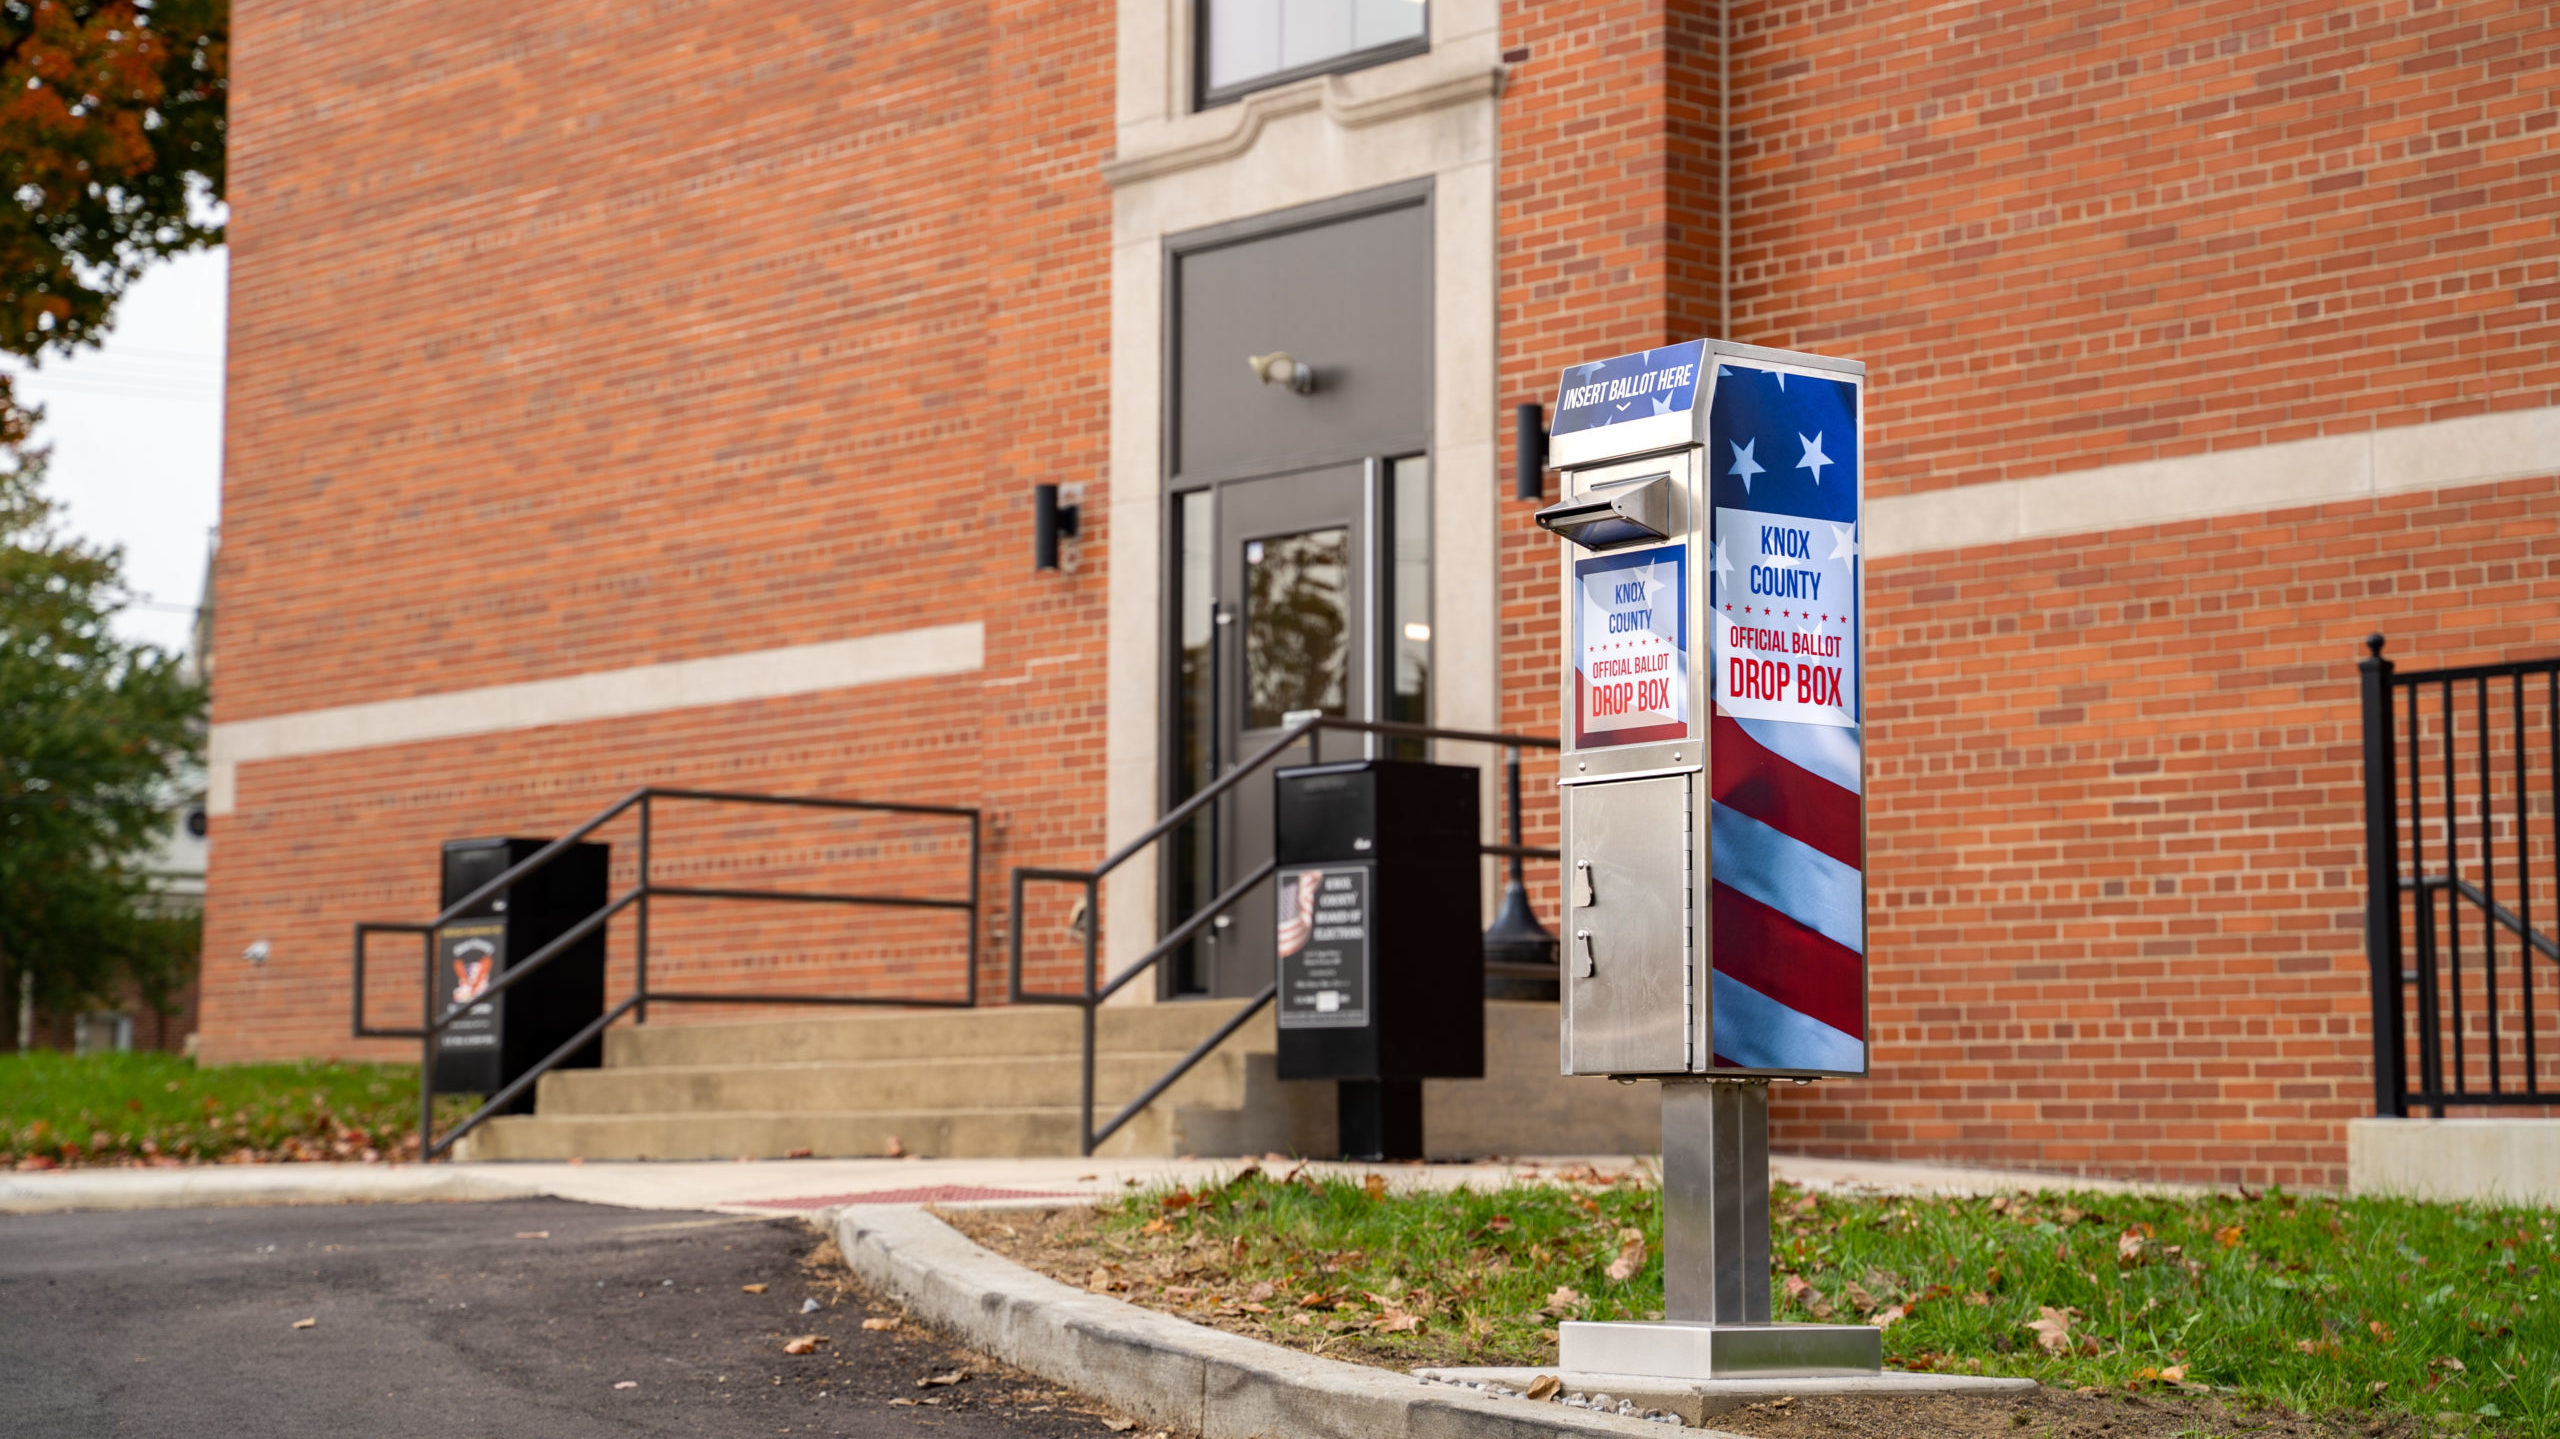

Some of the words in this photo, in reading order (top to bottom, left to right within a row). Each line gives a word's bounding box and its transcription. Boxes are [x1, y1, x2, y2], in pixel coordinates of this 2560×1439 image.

[1562, 381, 1609, 411] INSERT
[1608, 371, 1658, 402] BALLOT
[1656, 363, 1694, 391] HERE
[1761, 525, 1811, 560] KNOX
[1615, 581, 1646, 605] KNOX
[1750, 564, 1822, 601] COUNTY
[1609, 609, 1653, 634] COUNTY
[1730, 625, 1789, 653] OFFICIAL
[1792, 632, 1842, 658] BALLOT
[1592, 656, 1633, 679] OFFICIAL
[1634, 653, 1670, 675] BALLOT
[1730, 657, 1791, 702] DROP
[1797, 663, 1843, 707] BOX
[1592, 682, 1634, 717] DROP
[1638, 677, 1670, 712] BOX
